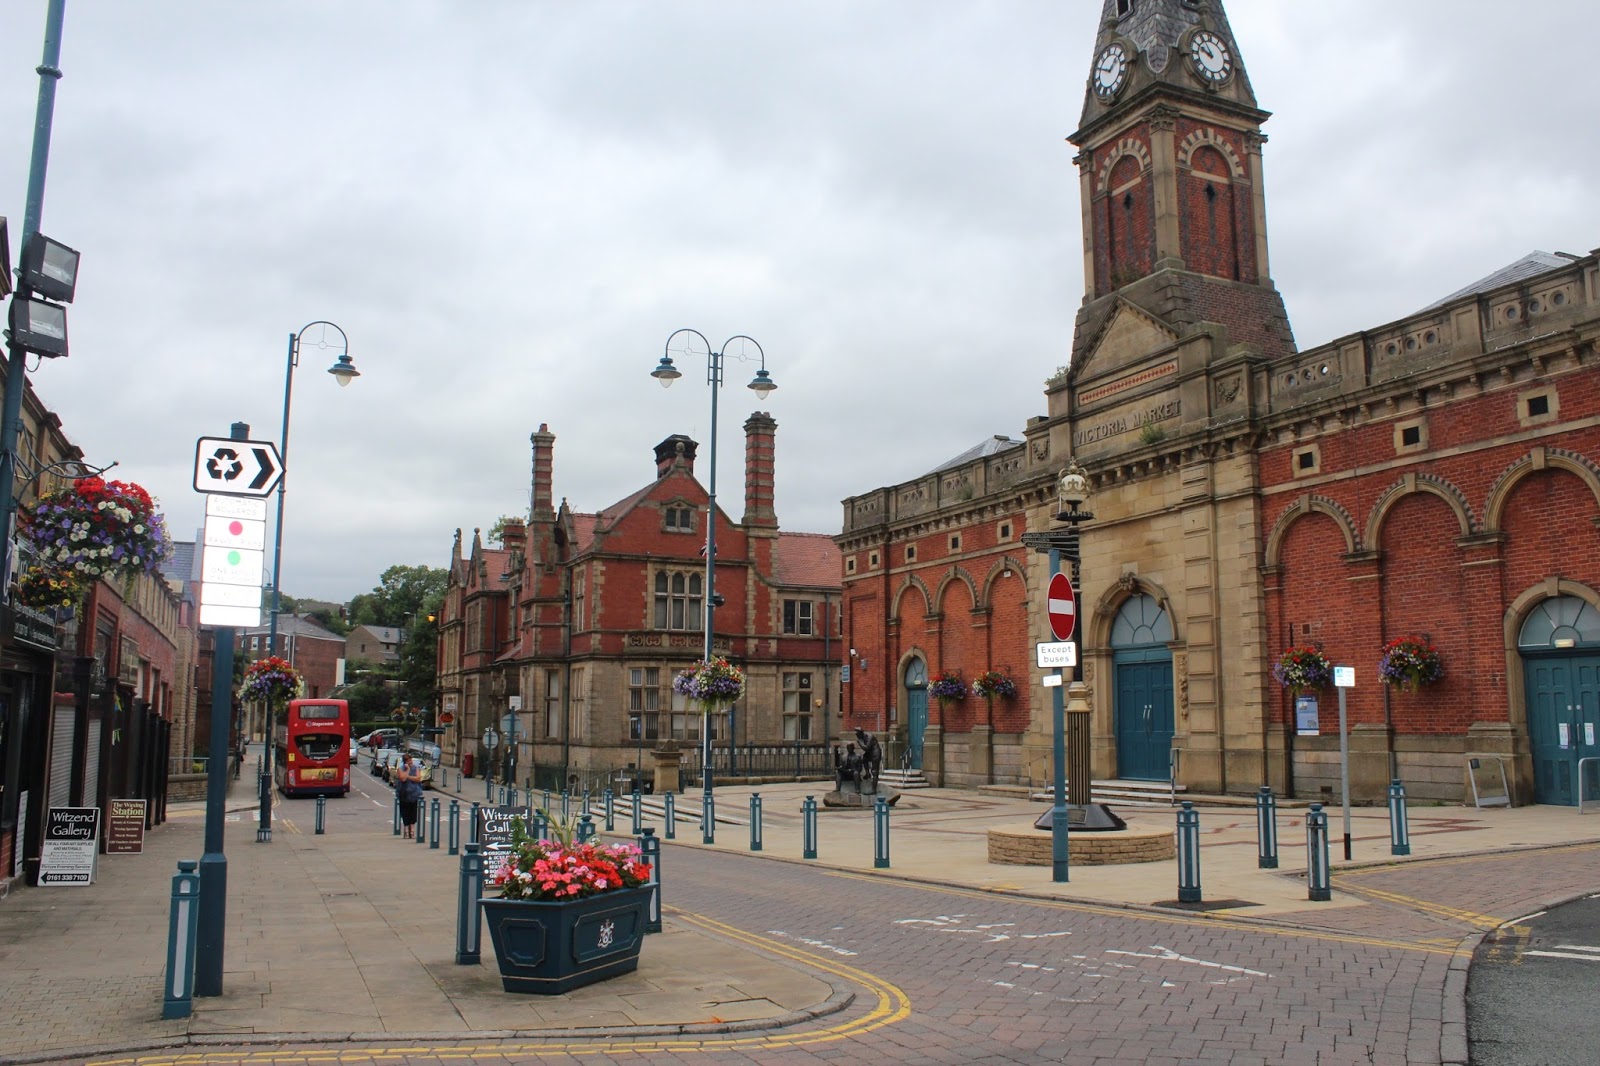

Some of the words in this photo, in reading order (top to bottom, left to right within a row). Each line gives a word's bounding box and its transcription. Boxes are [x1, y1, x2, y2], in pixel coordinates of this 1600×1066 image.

[1074, 418, 1127, 446] VICTORIA
[1133, 400, 1182, 428] MARKET
[1041, 646, 1072, 654] Except
[52, 810, 96, 822] Witzend
[112, 807, 144, 816] Station
[52, 823, 91, 840] Gallery
[482, 834, 506, 842] Trinity
